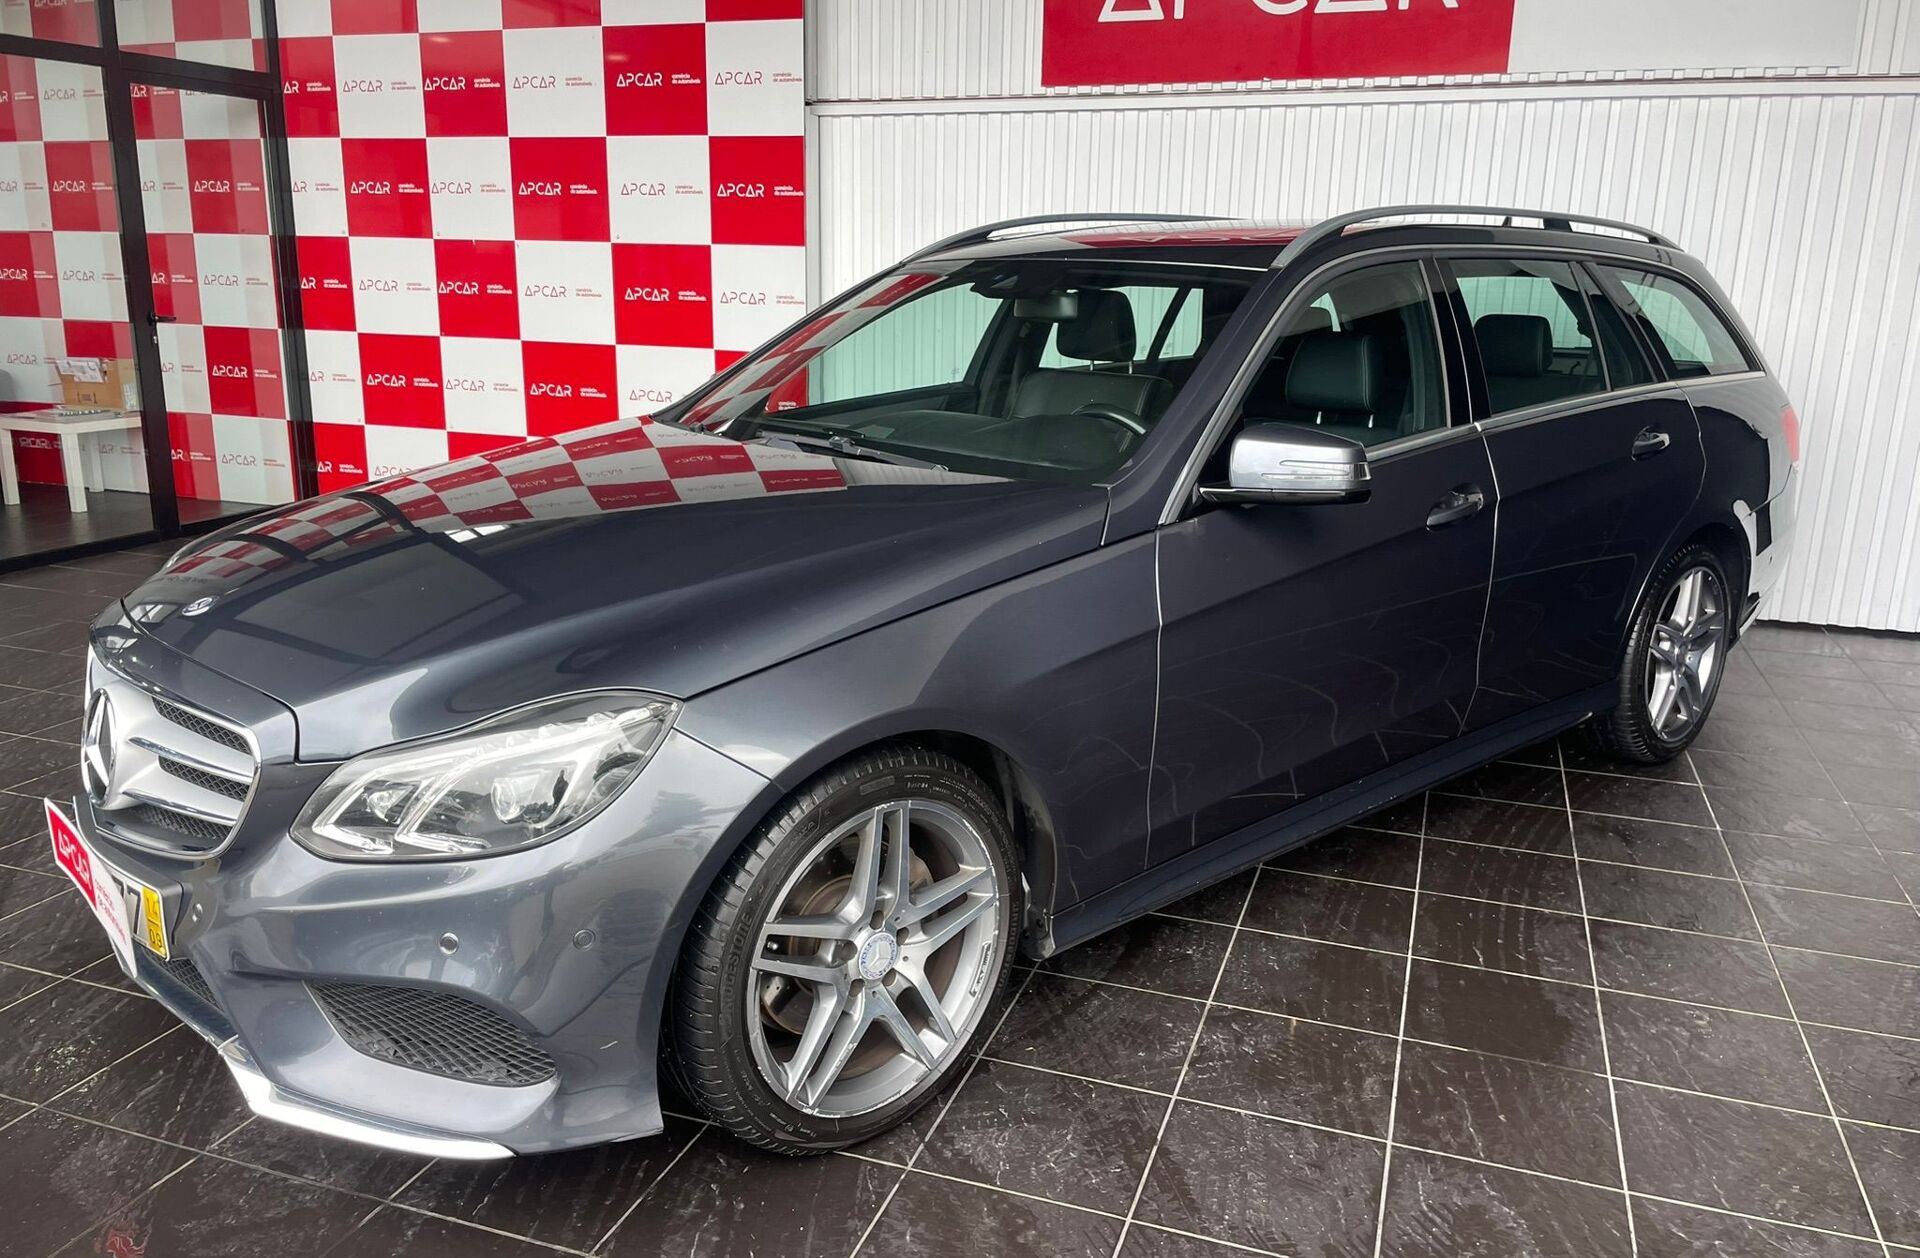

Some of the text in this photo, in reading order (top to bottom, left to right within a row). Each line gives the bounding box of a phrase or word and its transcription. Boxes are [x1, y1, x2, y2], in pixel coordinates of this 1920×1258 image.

[424, 77, 466, 91] APCAR
[512, 76, 556, 89] APCAR
[616, 73, 663, 87] APCAR
[715, 71, 763, 85] APCAR
[343, 80, 383, 92] APCAR
[43, 88, 76, 100] APCAR
[53, 180, 85, 192] APCAR
[194, 181, 230, 192] APCAR
[350, 181, 391, 194] APCAR
[432, 182, 471, 194] APCAR
[519, 182, 561, 196] APCAR
[620, 183, 665, 196] APCAR
[717, 183, 765, 198] APCAR
[63, 271, 95, 281] APCAR
[203, 274, 239, 286] APCAR
[359, 279, 398, 292] APCAR
[438, 281, 479, 295] APCAR
[525, 285, 567, 298] APCAR
[624, 287, 669, 301] APCAR
[720, 291, 766, 305] APCAR
[212, 365, 248, 378] APCAR
[366, 373, 406, 387] APCAR
[445, 379, 485, 392] APCAR
[530, 383, 572, 397] APCAR
[629, 389, 673, 403] APCAR
[222, 454, 257, 466] APCAR
